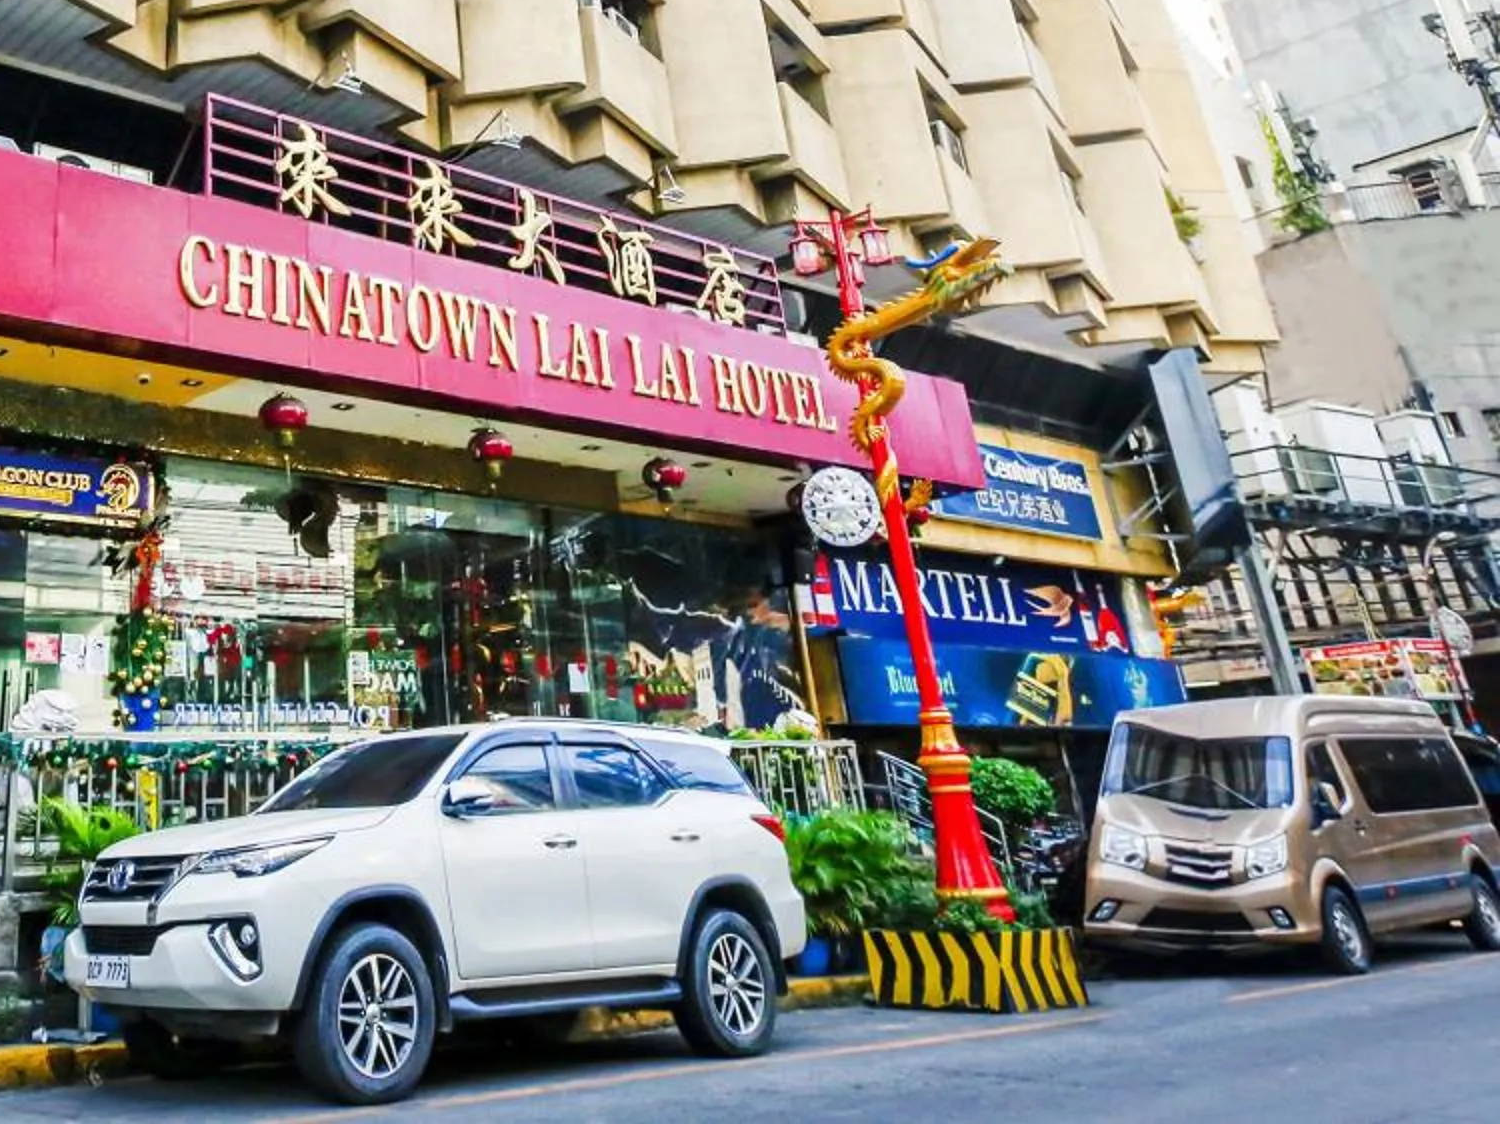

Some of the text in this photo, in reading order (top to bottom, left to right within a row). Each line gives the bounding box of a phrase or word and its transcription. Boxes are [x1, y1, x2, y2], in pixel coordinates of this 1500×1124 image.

[180, 235, 837, 432] CHINATOWN LAI LAI HOTEL
[44, 468, 92, 492] CLUB
[984, 451, 1049, 493] Century
